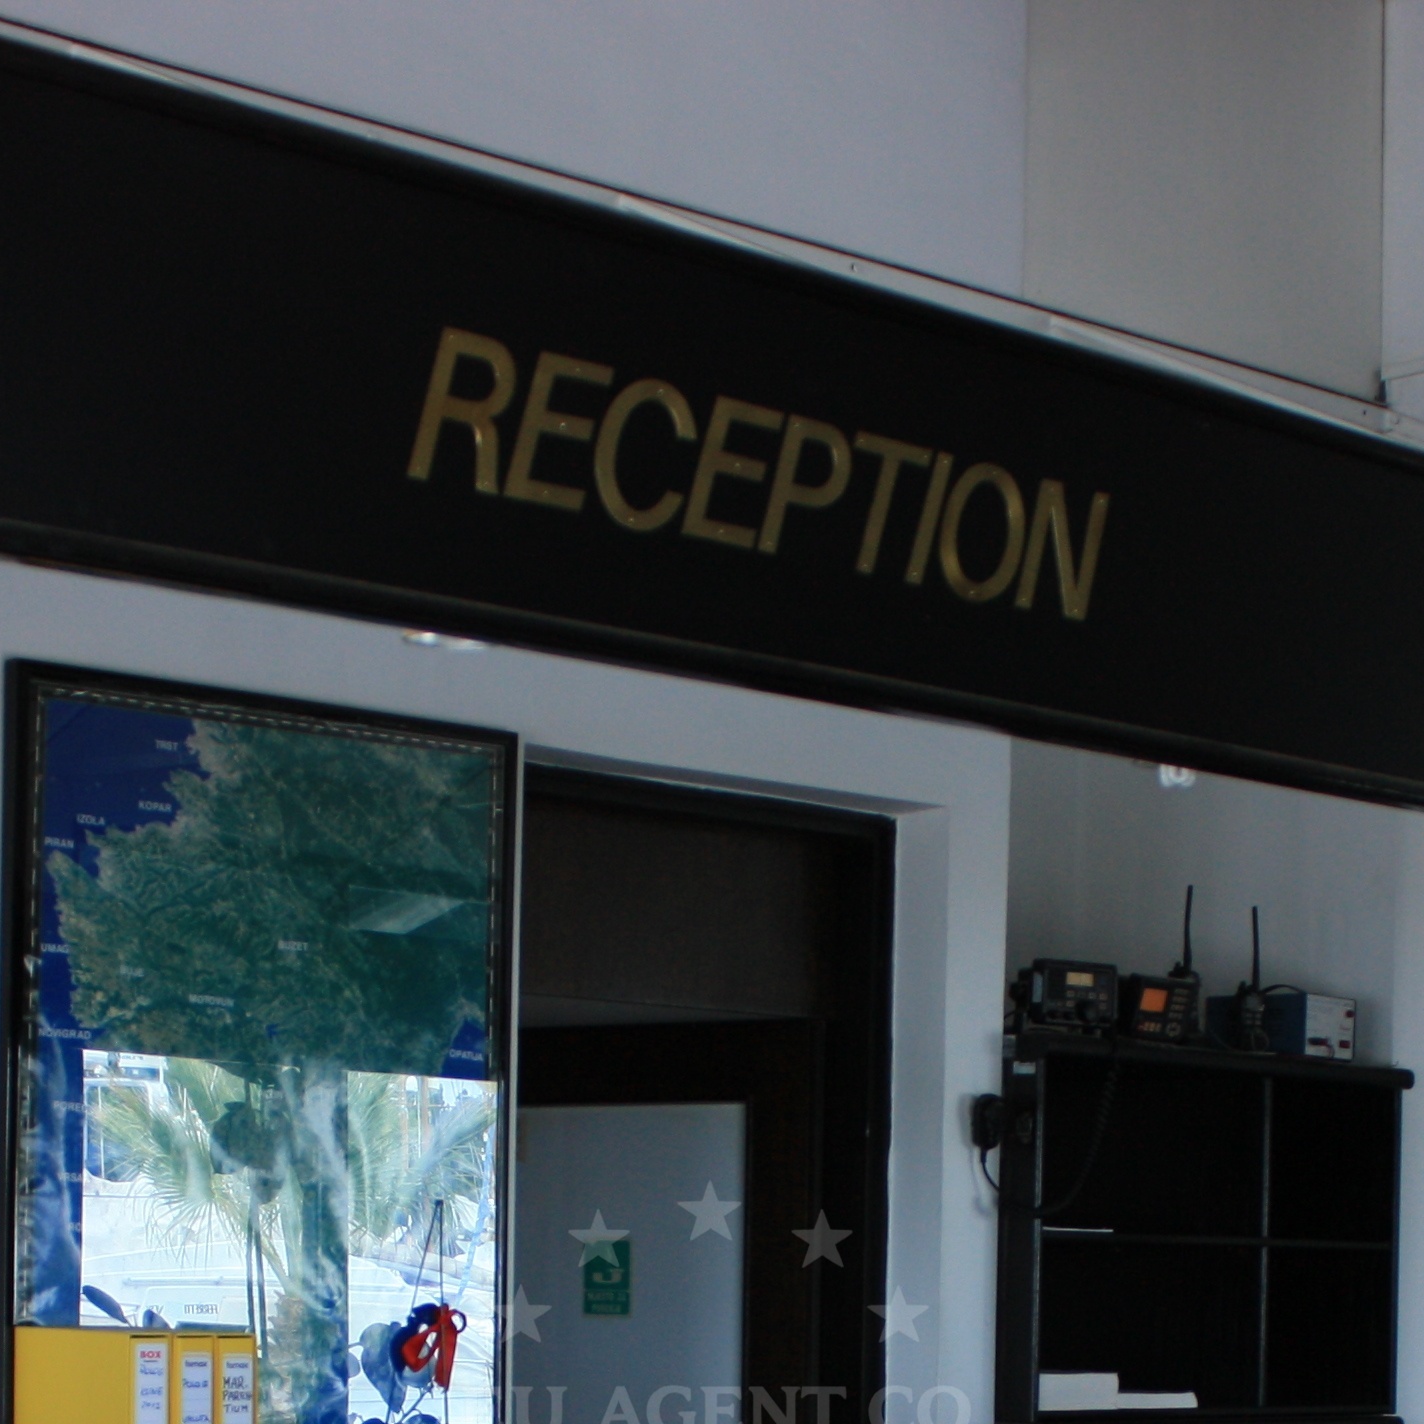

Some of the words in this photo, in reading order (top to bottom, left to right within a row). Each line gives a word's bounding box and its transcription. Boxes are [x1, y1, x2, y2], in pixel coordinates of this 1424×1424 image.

[406, 326, 1110, 621] RECEPTION
[138, 800, 173, 812] KOPAR
[76, 813, 106, 826] IZOLA
[44, 836, 74, 849] PIRAN
[38, 1027, 92, 1041] NOVIGRAD
[449, 1048, 484, 1061] OPATIJA
[139, 1350, 162, 1359] BOX
